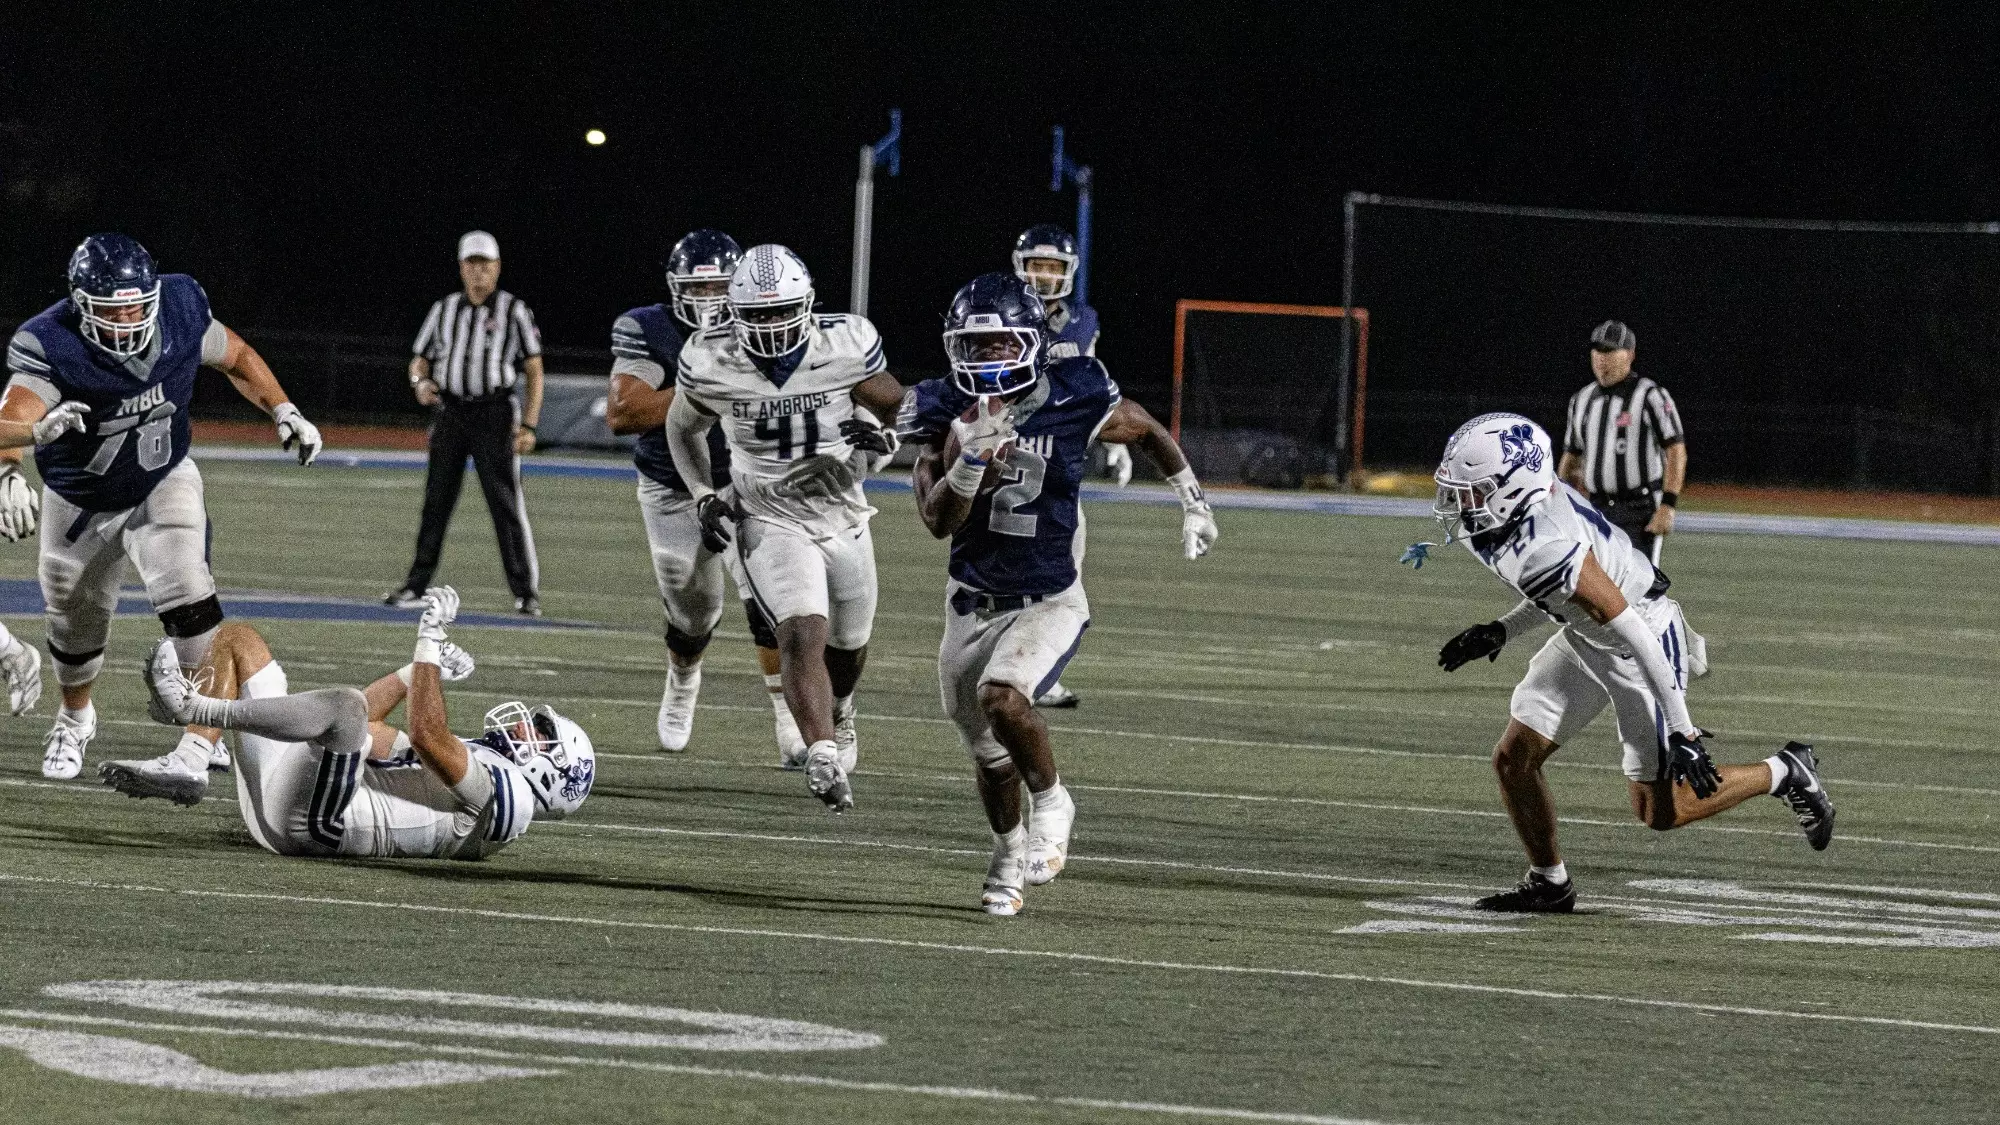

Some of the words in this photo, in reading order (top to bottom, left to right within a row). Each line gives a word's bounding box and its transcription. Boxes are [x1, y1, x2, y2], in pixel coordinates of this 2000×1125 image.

[974, 315, 991, 325] MBU
[115, 382, 166, 417] MBU
[758, 391, 832, 419] AMBROSE
[83, 400, 178, 476] 78
[754, 409, 820, 460] 41
[987, 442, 1048, 538] 2
[1511, 514, 1537, 559] 27
